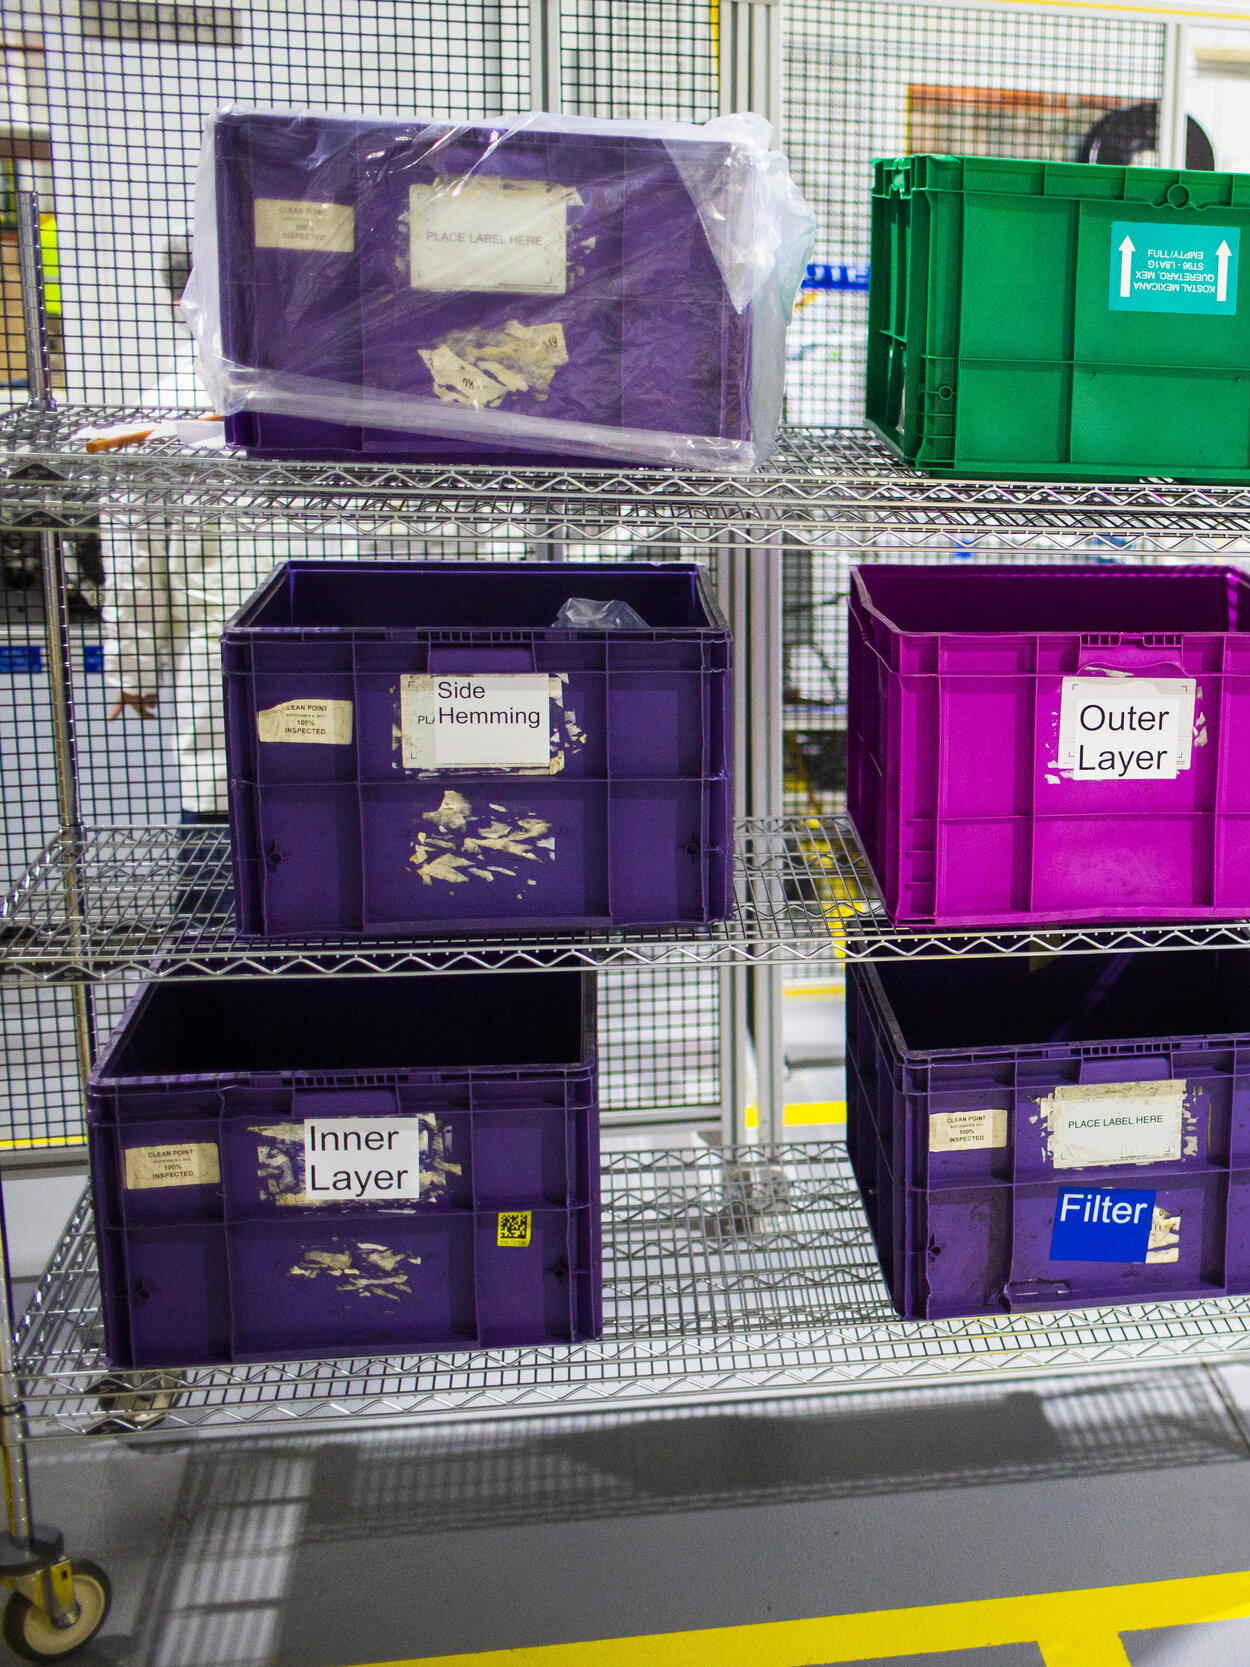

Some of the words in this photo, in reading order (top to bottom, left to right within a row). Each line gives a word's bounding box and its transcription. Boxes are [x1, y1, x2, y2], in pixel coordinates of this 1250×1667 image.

[426, 231, 466, 243] PLACE
[469, 233, 506, 245] LABEL
[510, 236, 543, 246] HERE
[1182, 262, 1204, 270] ST96
[1135, 270, 1156, 280] MEX
[1133, 282, 1180, 292] MEXICANA
[1182, 284, 1215, 293] KOSTAL
[438, 681, 486, 699] Side
[307, 704, 328, 712] POINT
[438, 706, 541, 729] Hemming
[1080, 704, 1170, 731] Outer
[1078, 744, 1168, 777] Layer
[946, 1116, 967, 1124] CLEAN
[1068, 1118, 1100, 1129] PLACE
[1103, 1116, 1134, 1126] LABEL
[1136, 1114, 1164, 1124] HERE
[310, 1125, 400, 1152] Inner
[948, 1135, 985, 1143] INSPECTED
[152, 1170, 194, 1179] INSPECTED
[310, 1164, 409, 1198] Layer
[1060, 1193, 1148, 1224] Filter
